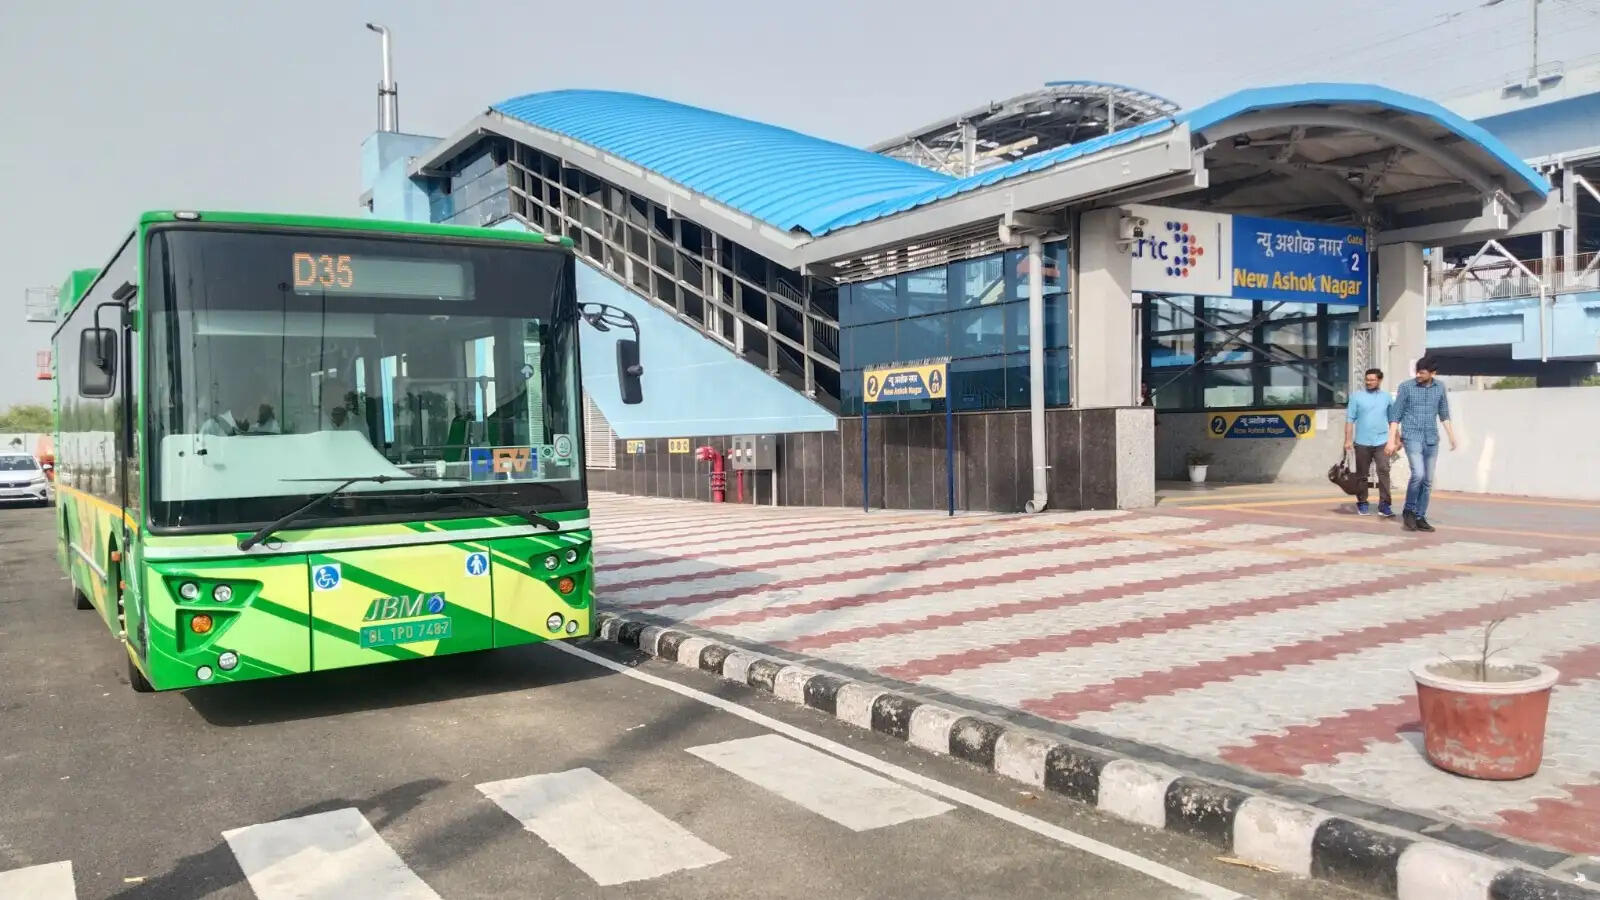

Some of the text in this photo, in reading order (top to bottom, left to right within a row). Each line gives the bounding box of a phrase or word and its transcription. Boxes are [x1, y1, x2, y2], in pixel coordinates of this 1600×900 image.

[1256, 230, 1343, 258] न्यू अशोक नगर
[292, 252, 353, 288] D35
[1351, 252, 1360, 272] 2
[1233, 267, 1362, 299] New Ashok Nagar
[869, 377, 876, 395] 2
[1214, 416, 1223, 432] 2
[363, 593, 425, 621] JBM
